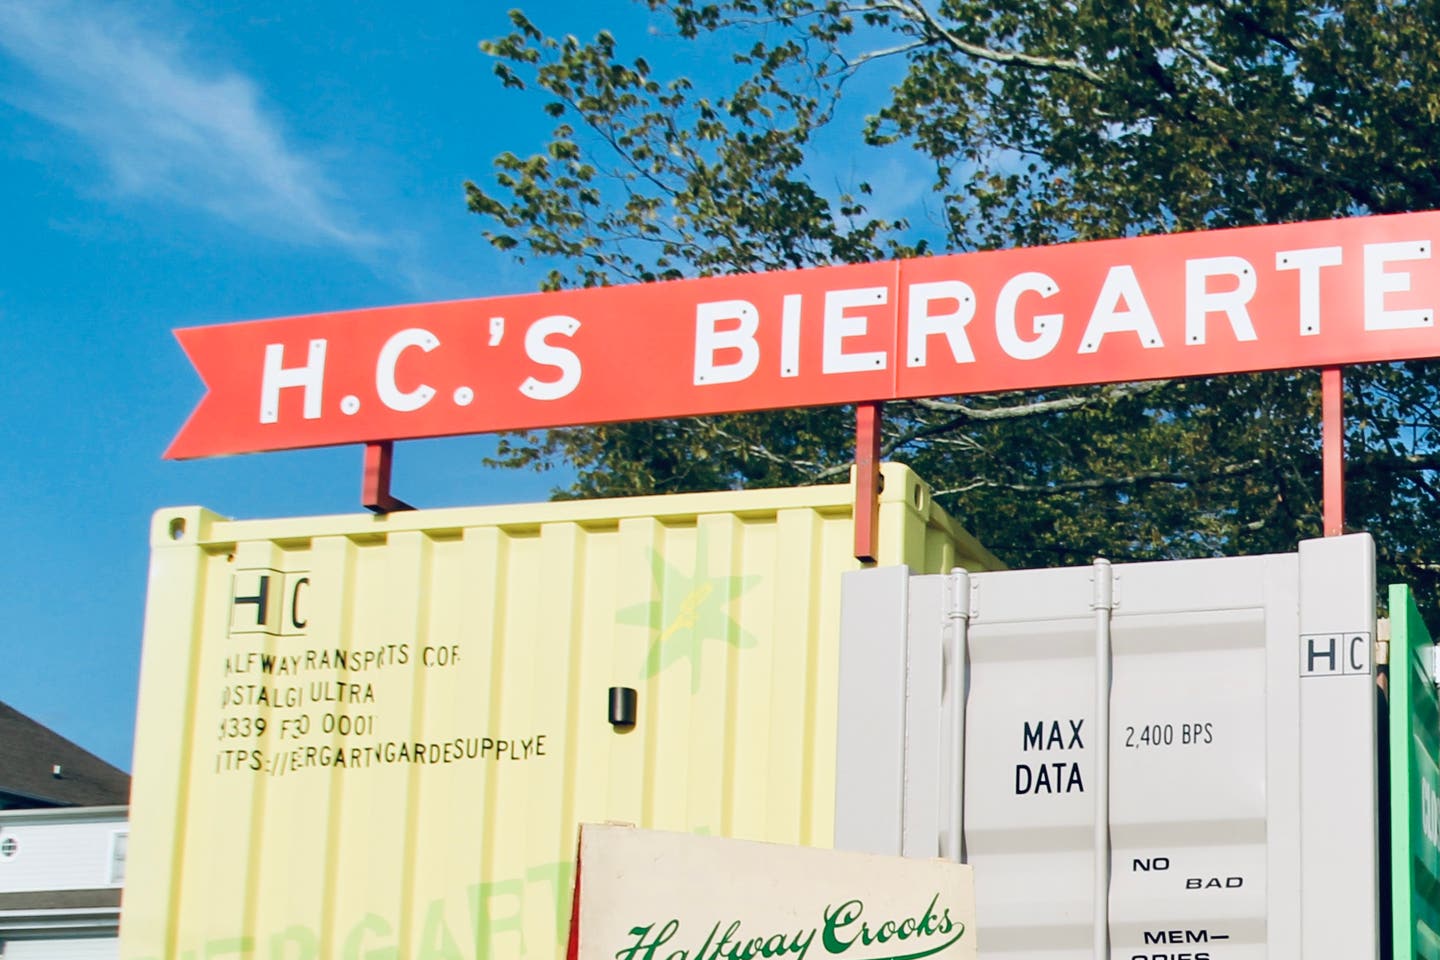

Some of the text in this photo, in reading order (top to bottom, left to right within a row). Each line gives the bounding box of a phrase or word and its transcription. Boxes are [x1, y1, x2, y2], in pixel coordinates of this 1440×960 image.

[259, 314, 583, 425] H.C.'S
[310, 681, 375, 704] ULTRA
[1024, 720, 1212, 751] MAX 2,400 BPS
[1016, 762, 1084, 794] DATA
[1133, 858, 1169, 871] NO
[1186, 877, 1243, 889] BAD
[821, 892, 966, 955] Crooks
